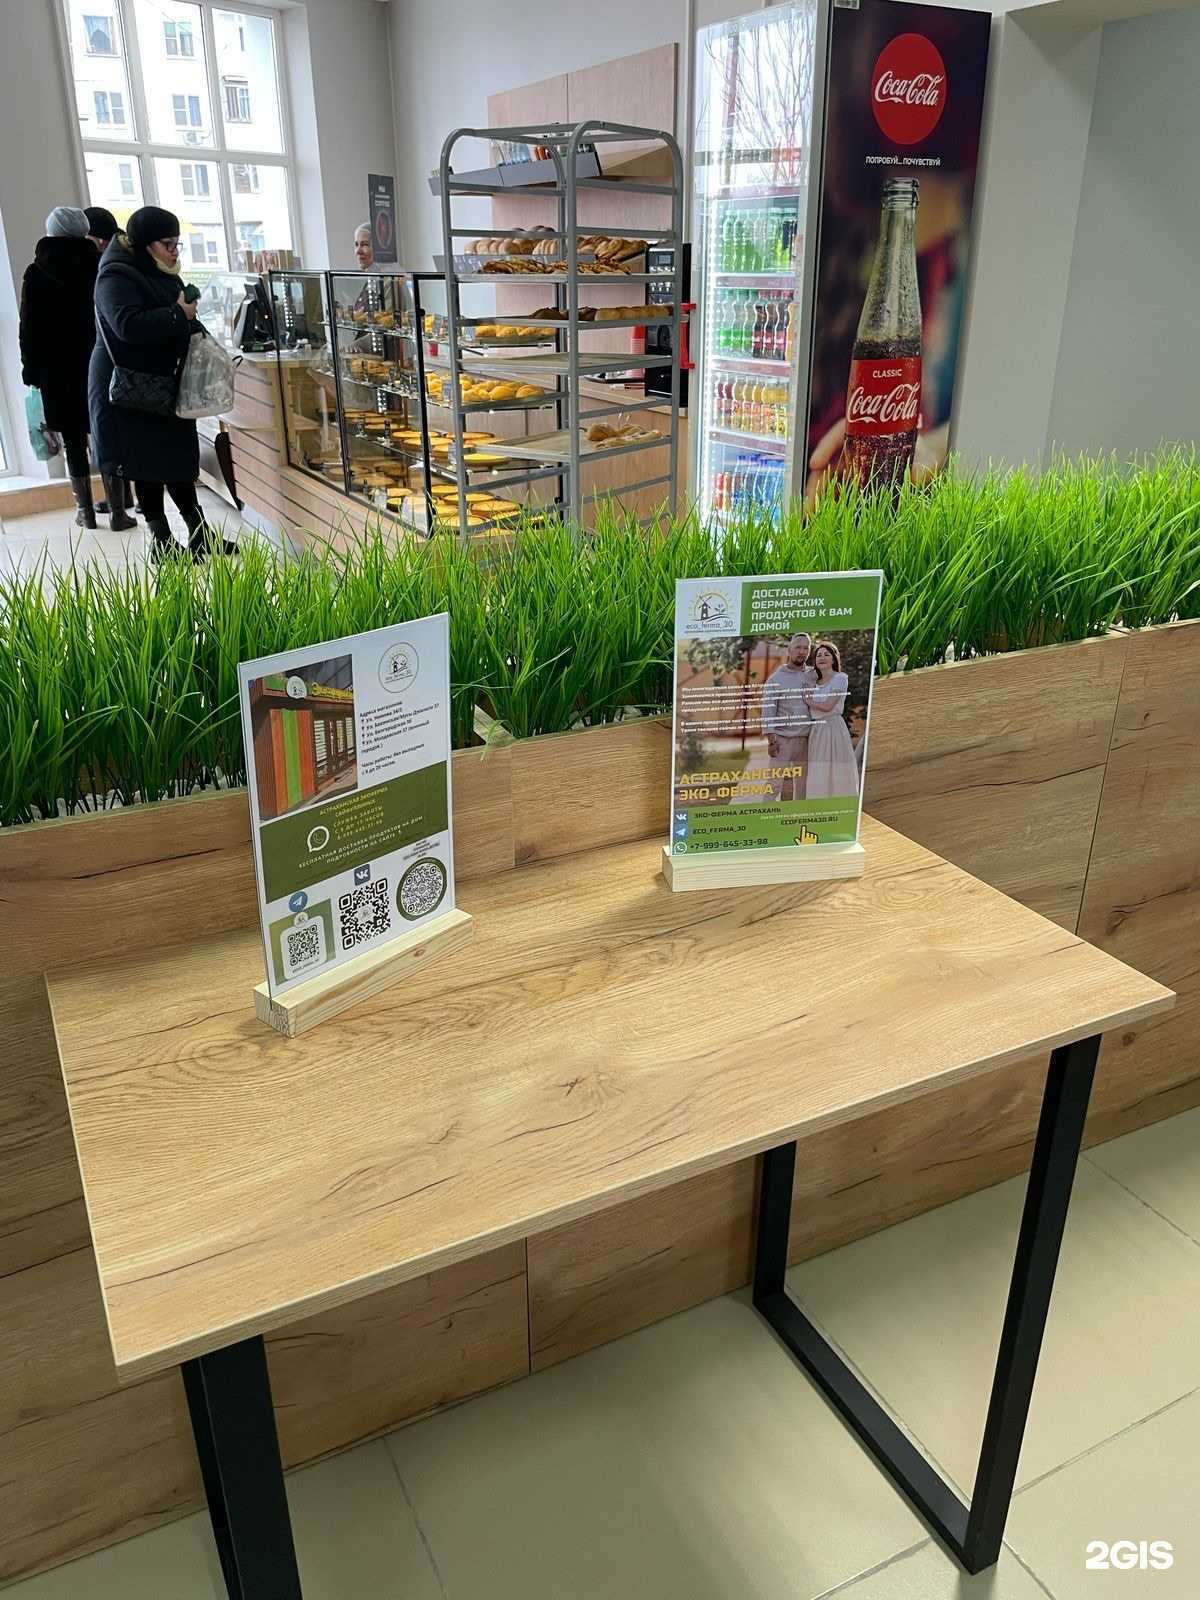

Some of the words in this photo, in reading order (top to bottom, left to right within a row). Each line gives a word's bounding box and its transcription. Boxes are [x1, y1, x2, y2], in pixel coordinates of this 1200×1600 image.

[874, 70, 944, 106] Coca-Cola
[872, 368, 903, 379] CLASSIC
[846, 382, 921, 424] Coca-Cola
[752, 587, 809, 600] ДОСТАВКА
[752, 598, 825, 609] ФЕРМЕРСКИХ
[751, 609, 816, 620] ПРОДУКТОВ
[819, 608, 826, 617] К
[829, 607, 853, 616] ВАМ
[750, 620, 791, 632] ДОМОЙ
[679, 766, 803, 785] АСТРАХАНСКАЯ
[679, 783, 774, 801] ЭКО_ФЕРМА
